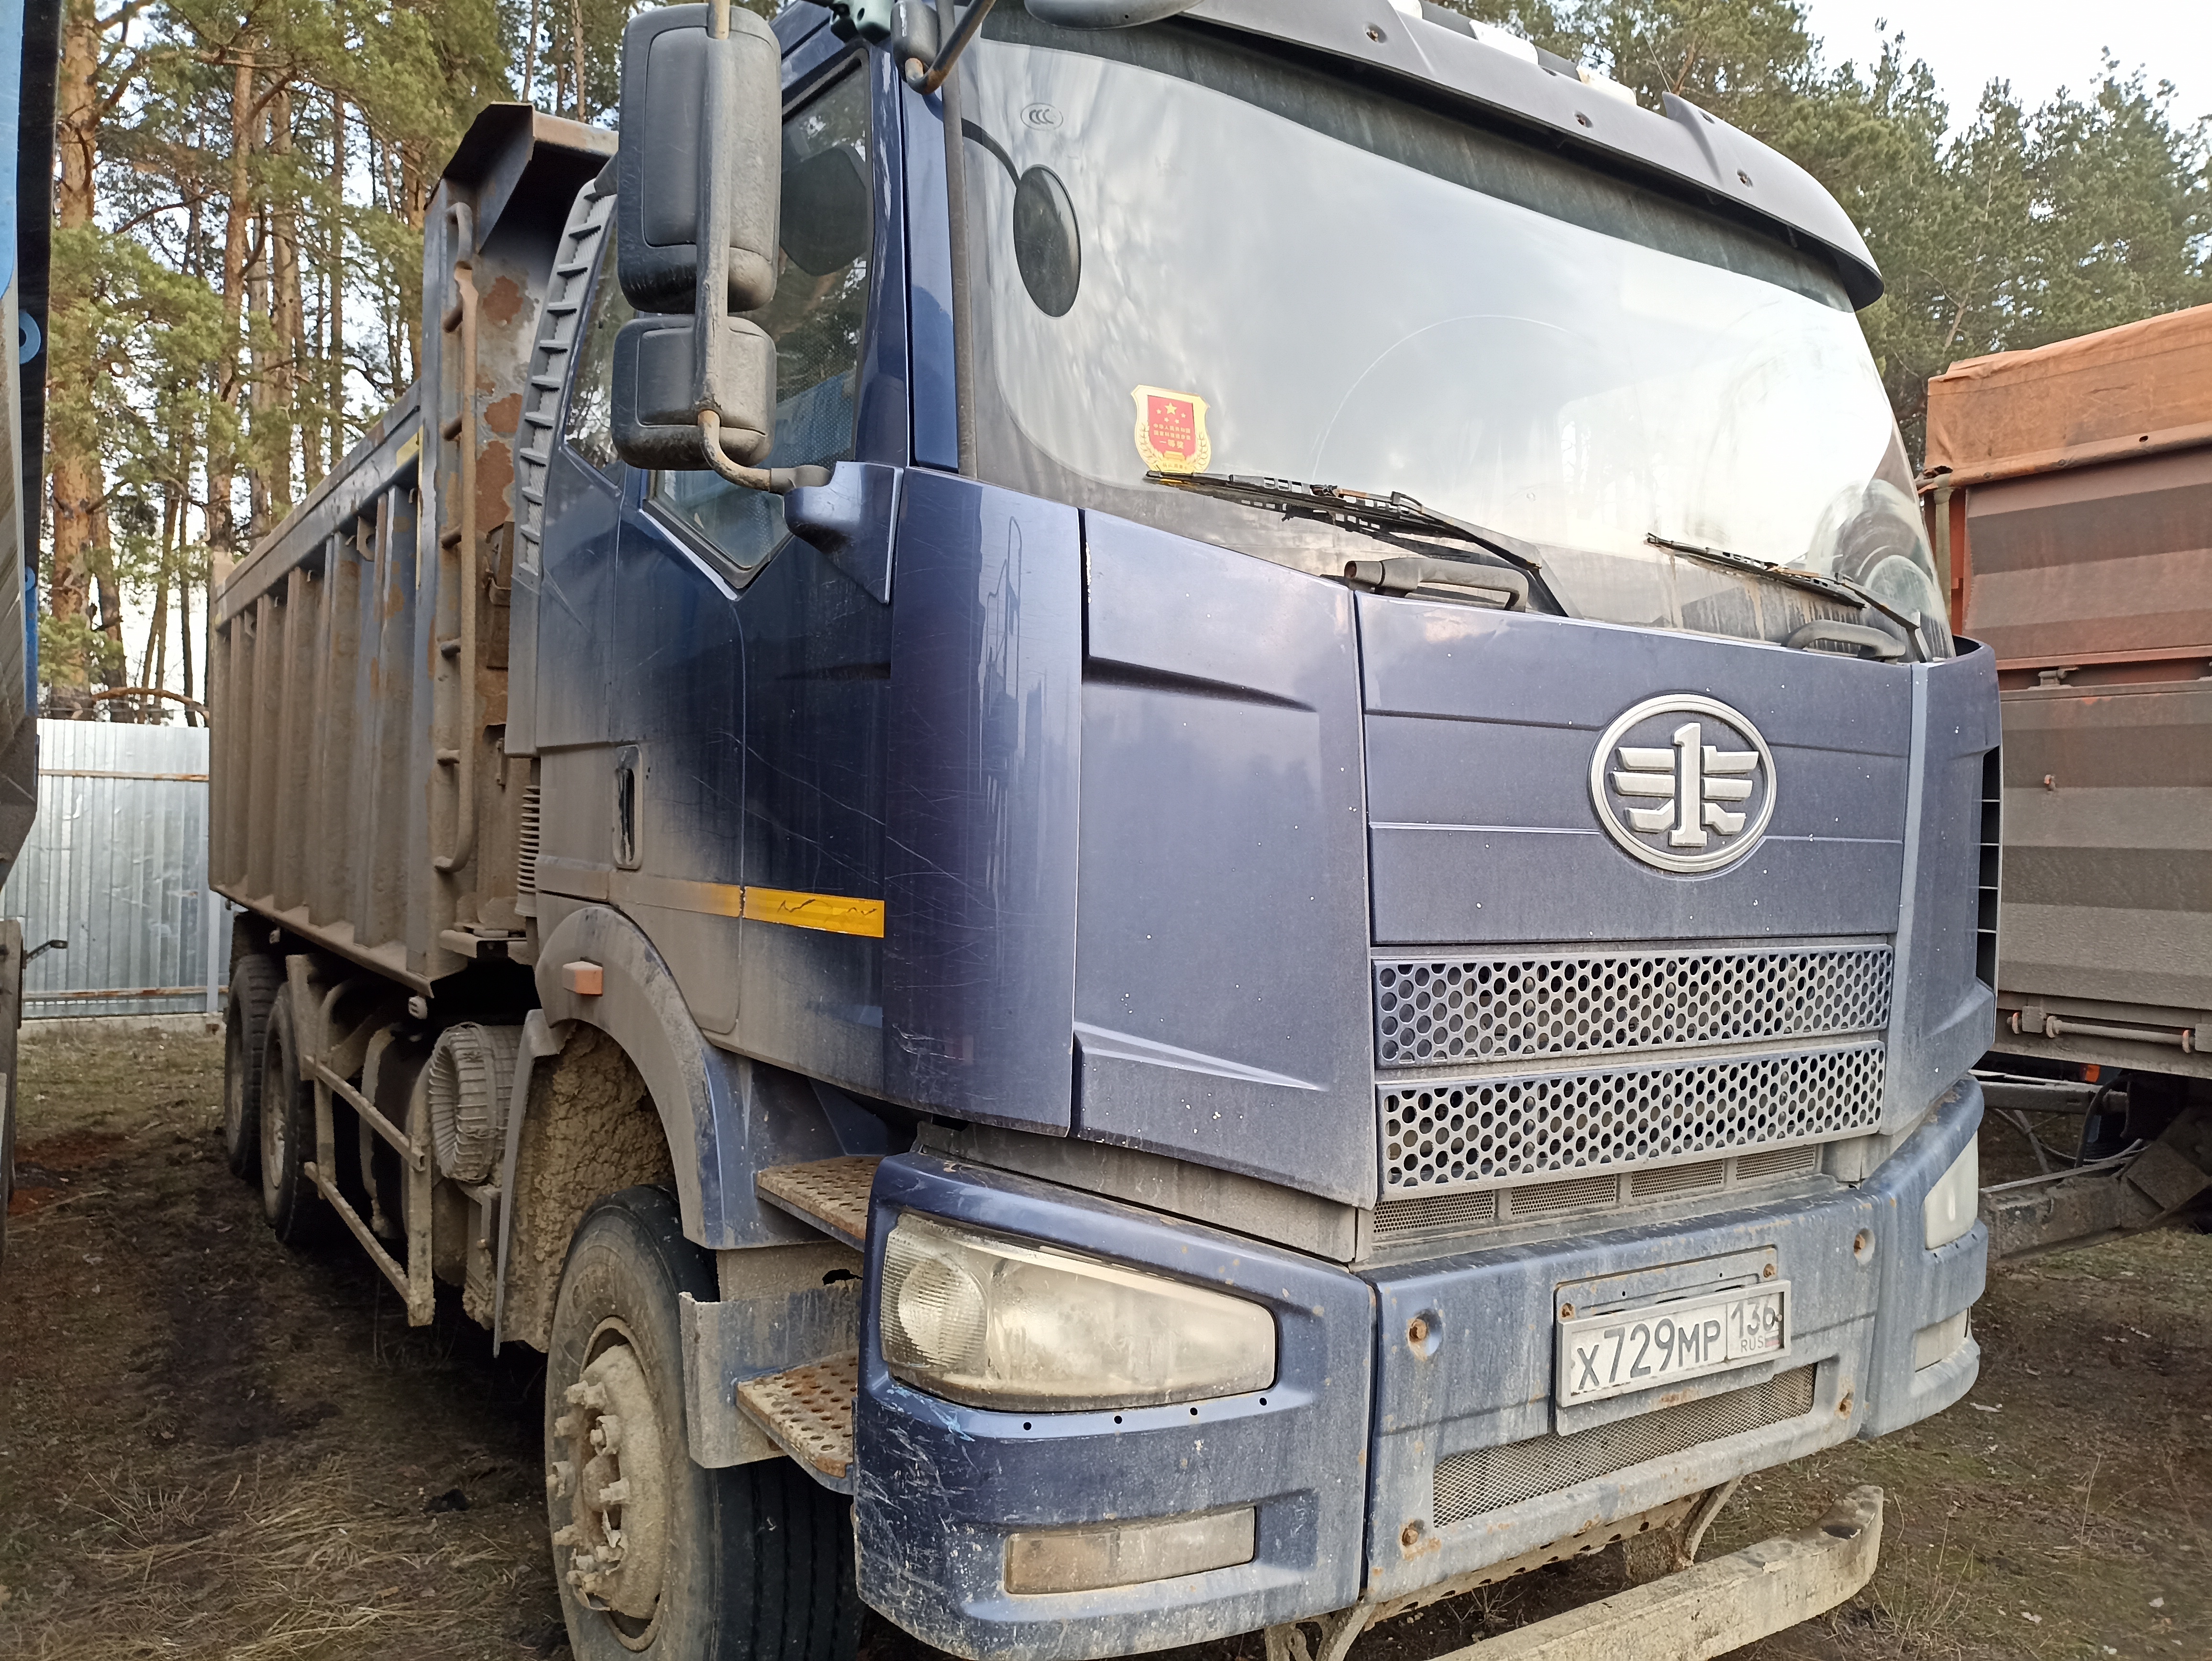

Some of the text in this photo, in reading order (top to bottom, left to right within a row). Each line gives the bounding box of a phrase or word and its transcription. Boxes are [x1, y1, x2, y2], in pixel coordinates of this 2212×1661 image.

[1577, 1295, 1777, 1390] Х729МР 136
[1740, 1335, 1764, 1353] RUS
